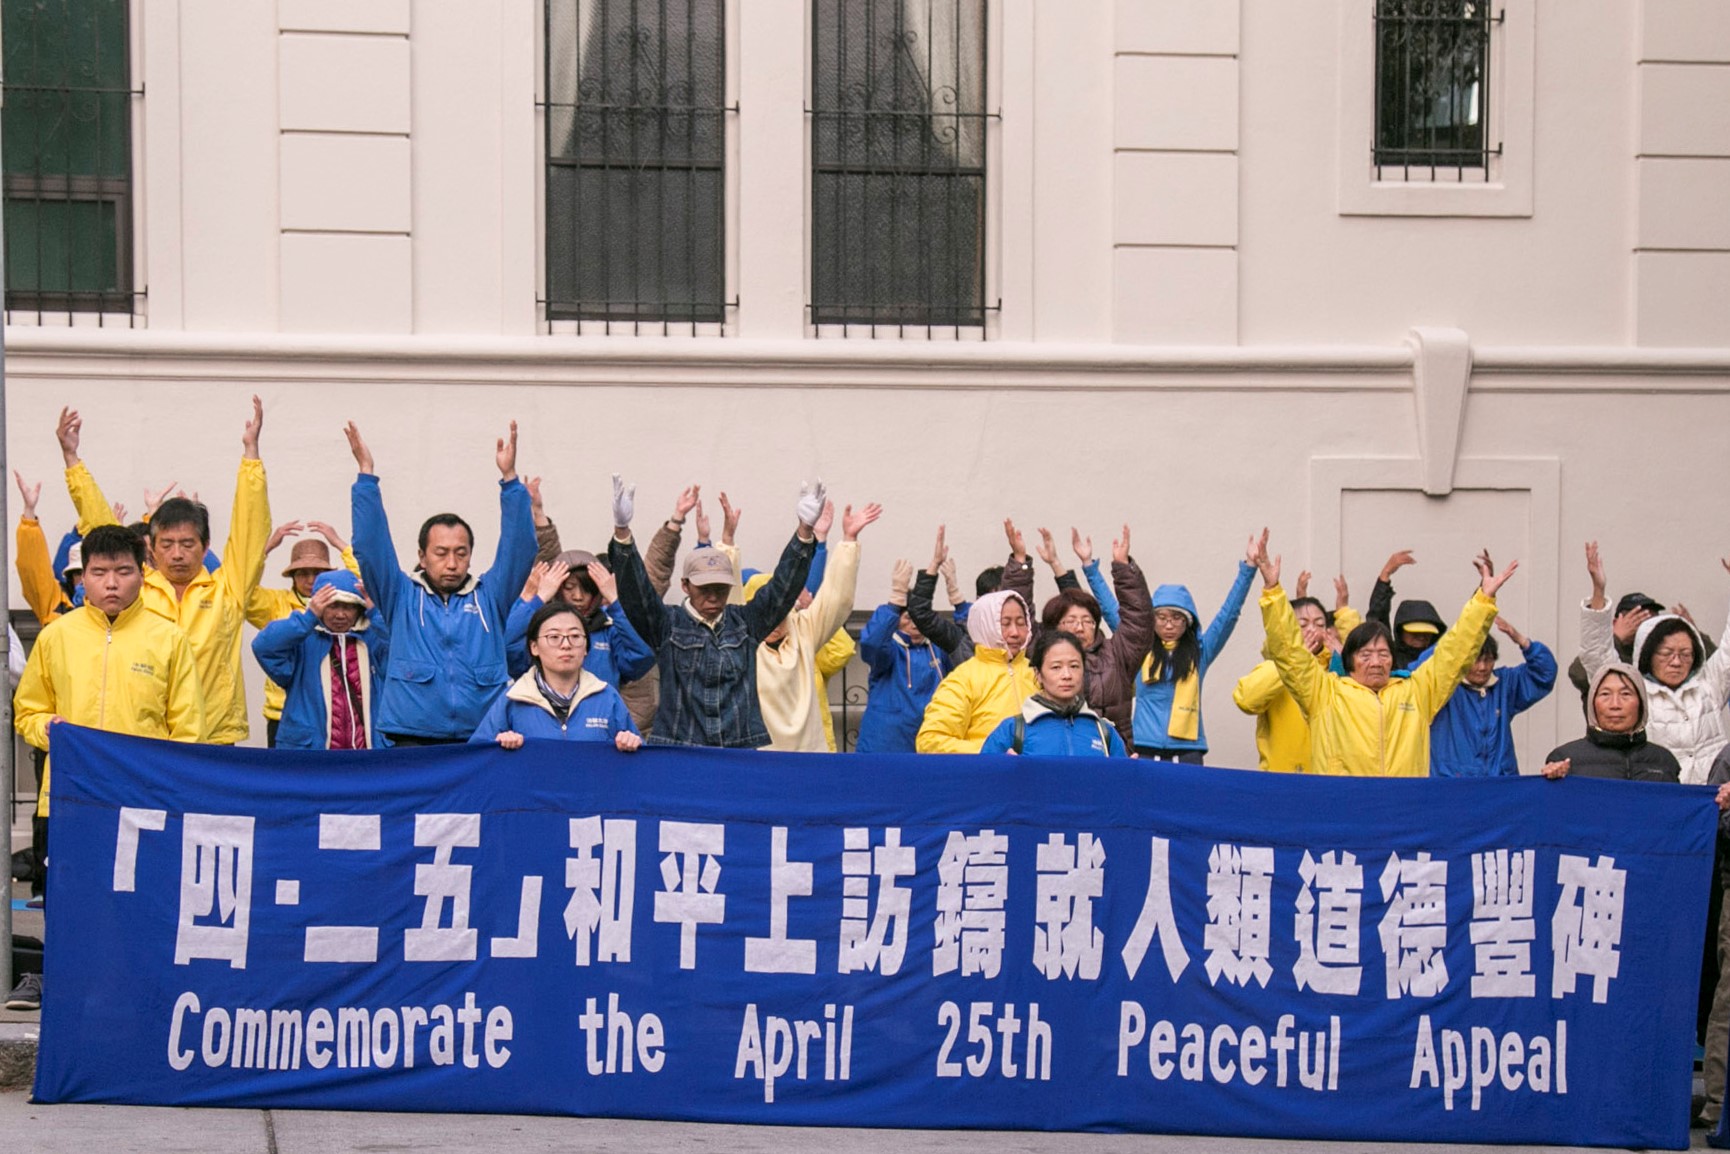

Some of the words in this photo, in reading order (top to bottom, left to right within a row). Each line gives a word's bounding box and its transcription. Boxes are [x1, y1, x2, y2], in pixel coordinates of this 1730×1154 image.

[168, 991, 514, 1077] Commemorate
[578, 992, 666, 1077] the
[734, 1003, 854, 1104] April
[936, 1000, 1052, 1081] 25th
[1117, 1000, 1341, 1092] Peaceful
[1409, 1014, 1568, 1112] Appeal
